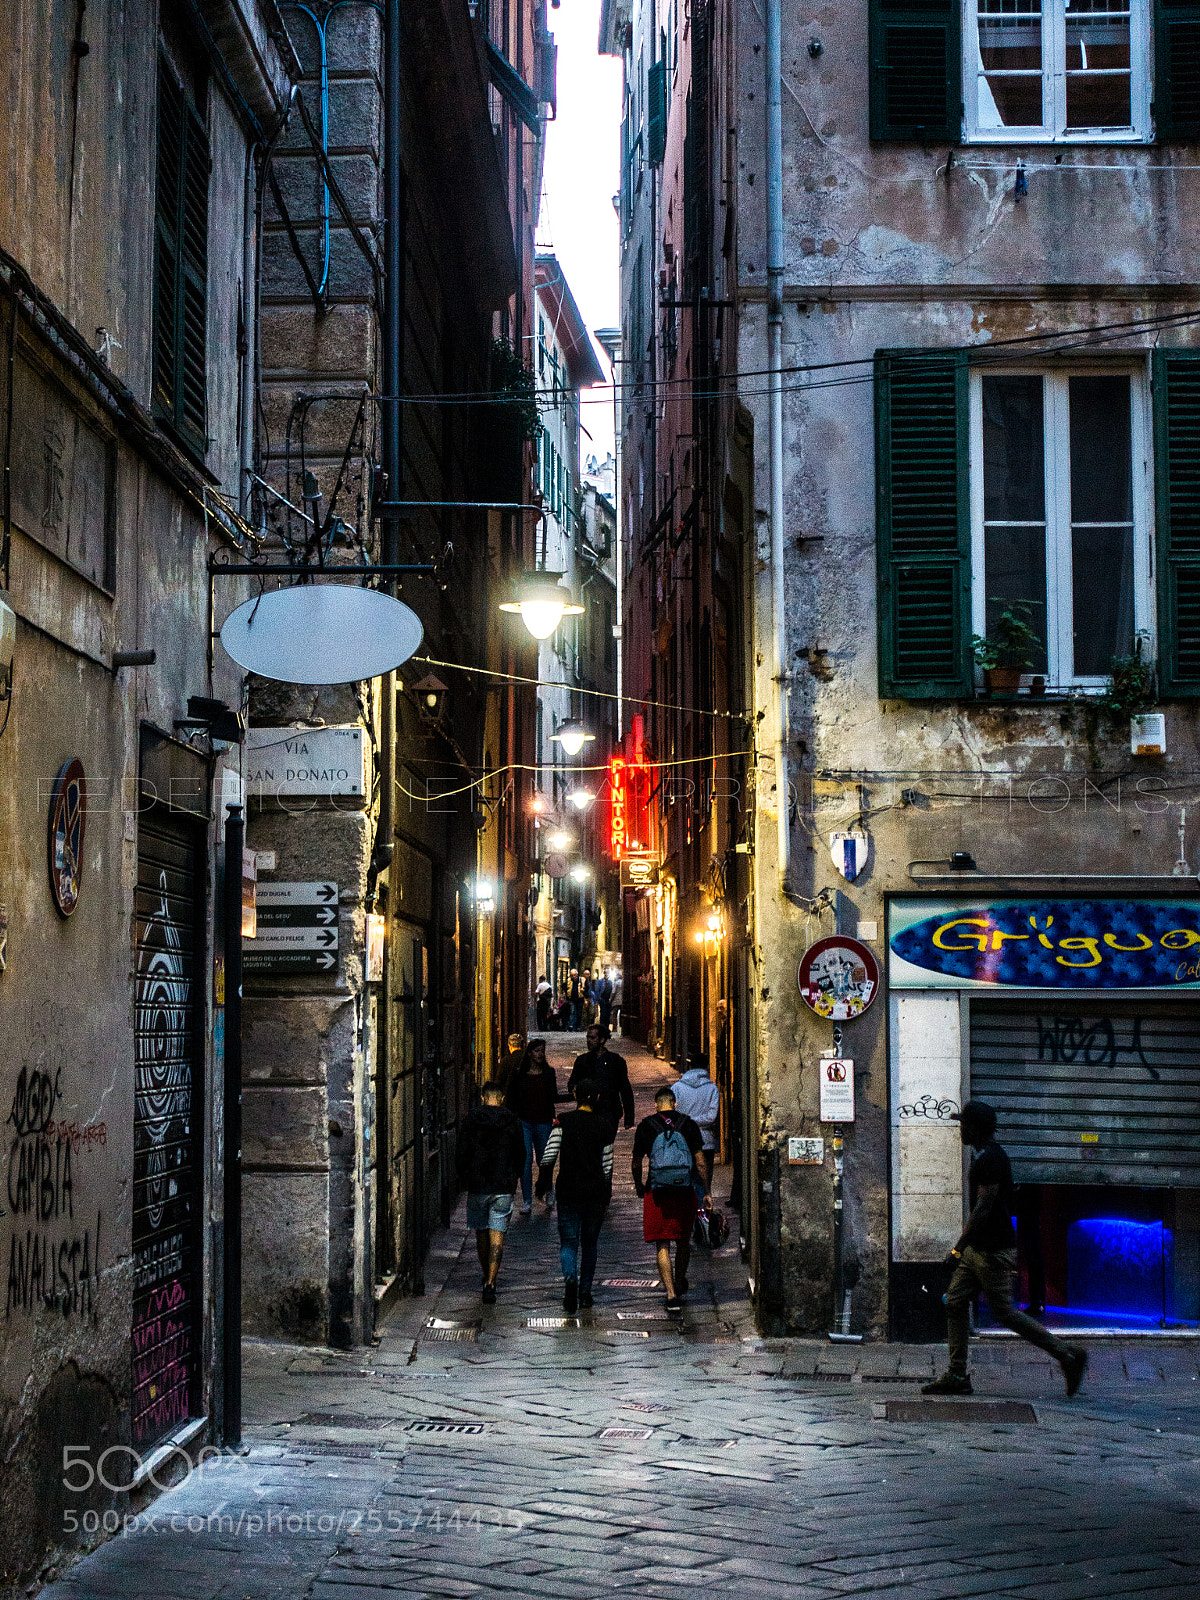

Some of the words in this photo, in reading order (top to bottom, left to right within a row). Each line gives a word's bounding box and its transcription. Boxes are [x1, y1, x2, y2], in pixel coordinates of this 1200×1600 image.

[284, 742, 309, 755] VIA
[246, 769, 275, 782] SAN
[286, 769, 349, 782] DONATO
[612, 760, 624, 858] PINTORI
[8, 1135, 73, 1222] CAMBIA
